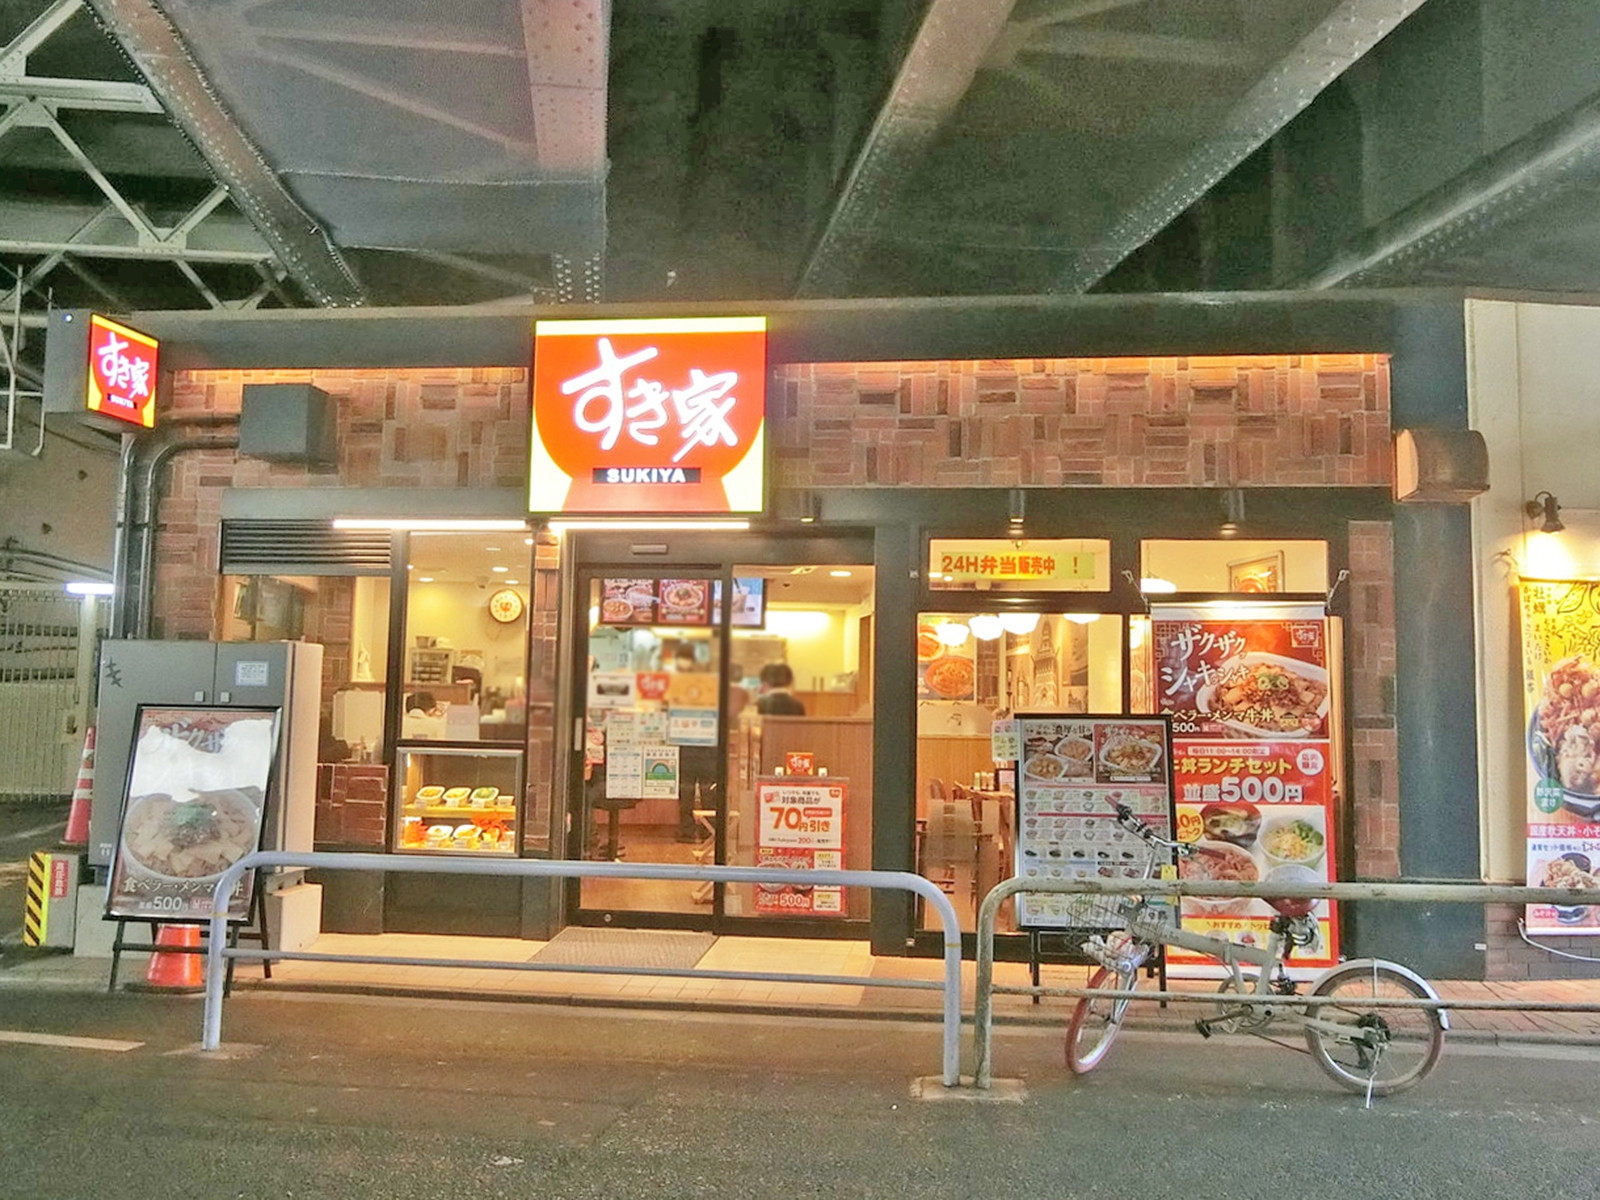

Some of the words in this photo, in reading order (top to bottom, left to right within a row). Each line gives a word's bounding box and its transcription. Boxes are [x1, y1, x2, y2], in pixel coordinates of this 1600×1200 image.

[97, 331, 150, 399] すき家
[561, 337, 738, 462] すき家
[606, 468, 686, 483] SUKIYA
[942, 555, 1055, 575] 24H弁当販売中
[1183, 776, 1303, 803] 並盛500円
[769, 806, 831, 832] 70円引き
[1177, 813, 1201, 829] 0円
[123, 877, 244, 896] 食べラー・メンマ丼
